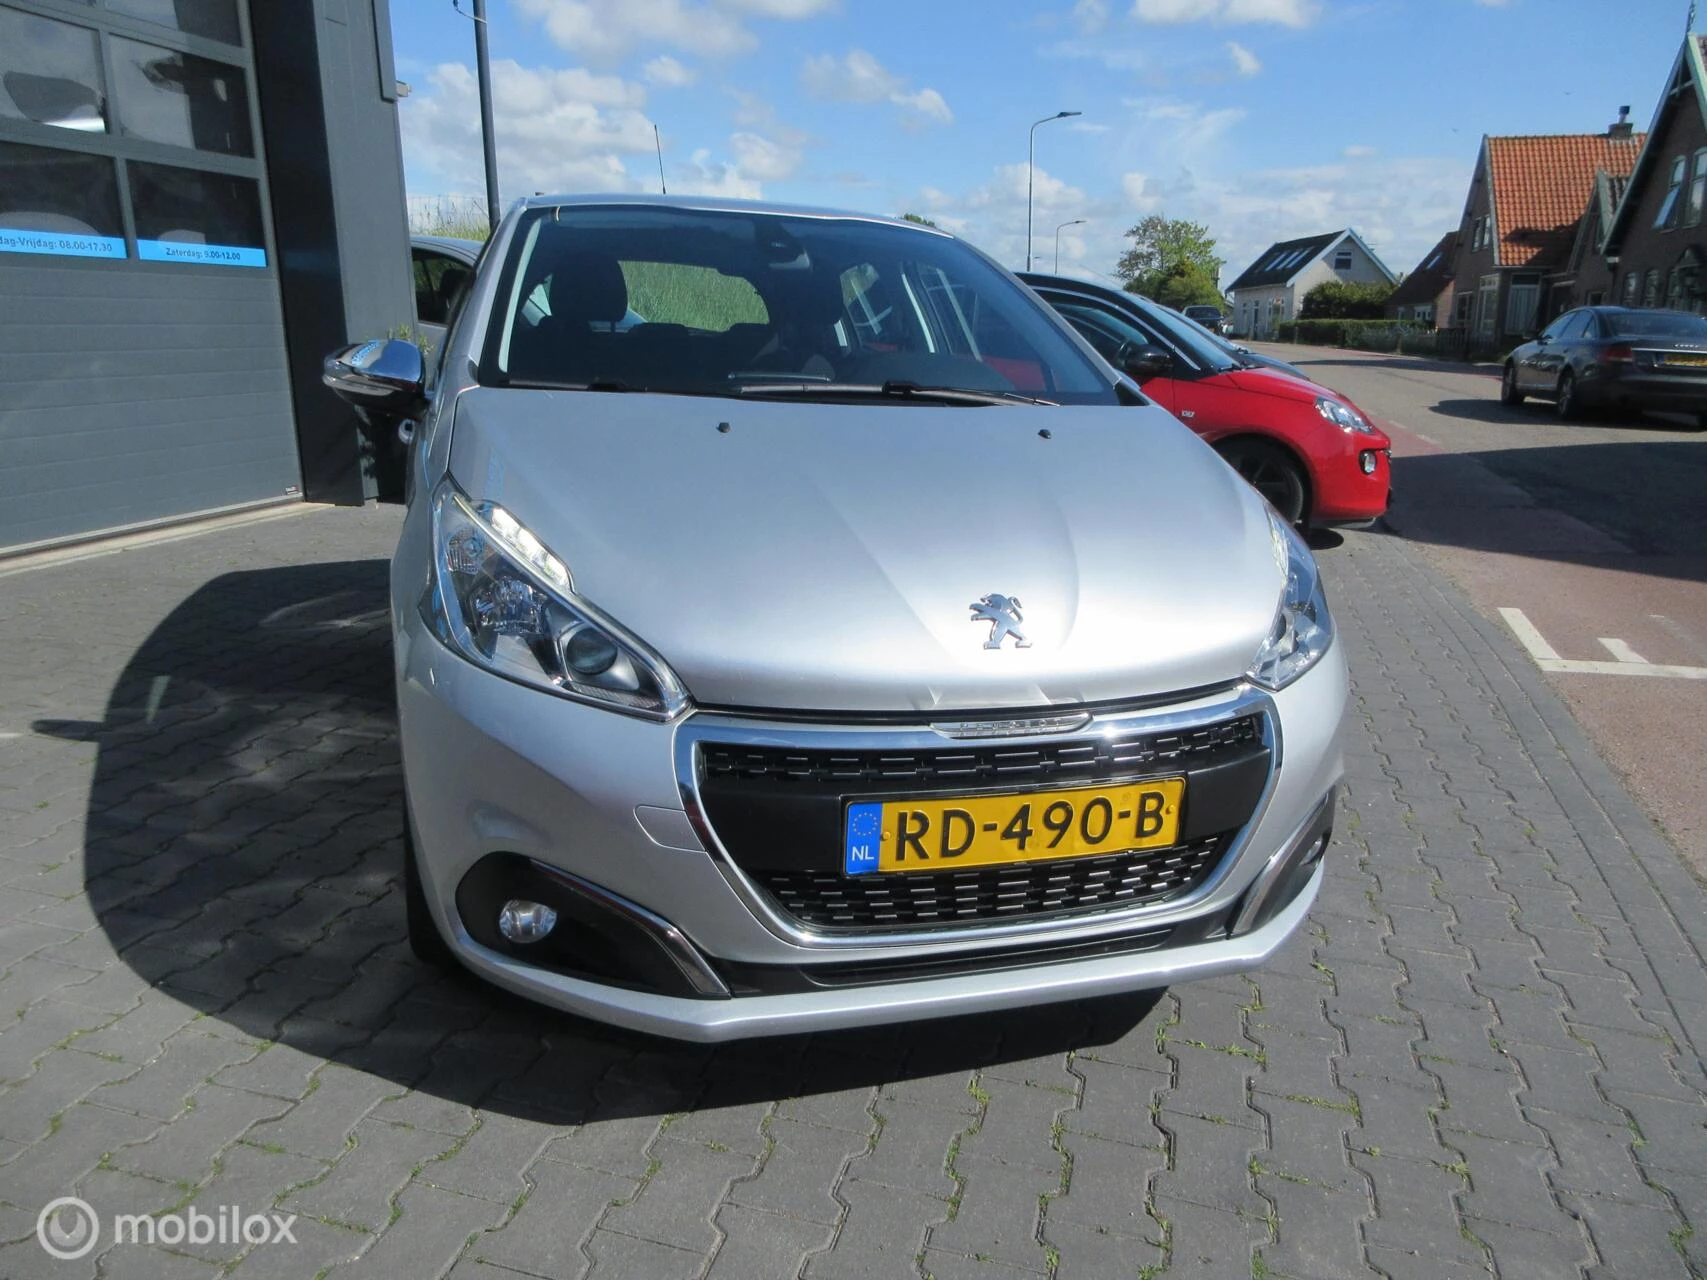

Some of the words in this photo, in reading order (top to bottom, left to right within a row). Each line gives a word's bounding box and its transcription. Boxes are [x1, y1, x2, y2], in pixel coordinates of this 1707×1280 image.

[60, 240, 113, 252] 08.00-17.30
[165, 247, 203, 260] Zaterdag:
[204, 250, 241, 261] 9.00-12.00
[895, 790, 1167, 862] RD-490-B
[851, 845, 875, 862] NL
